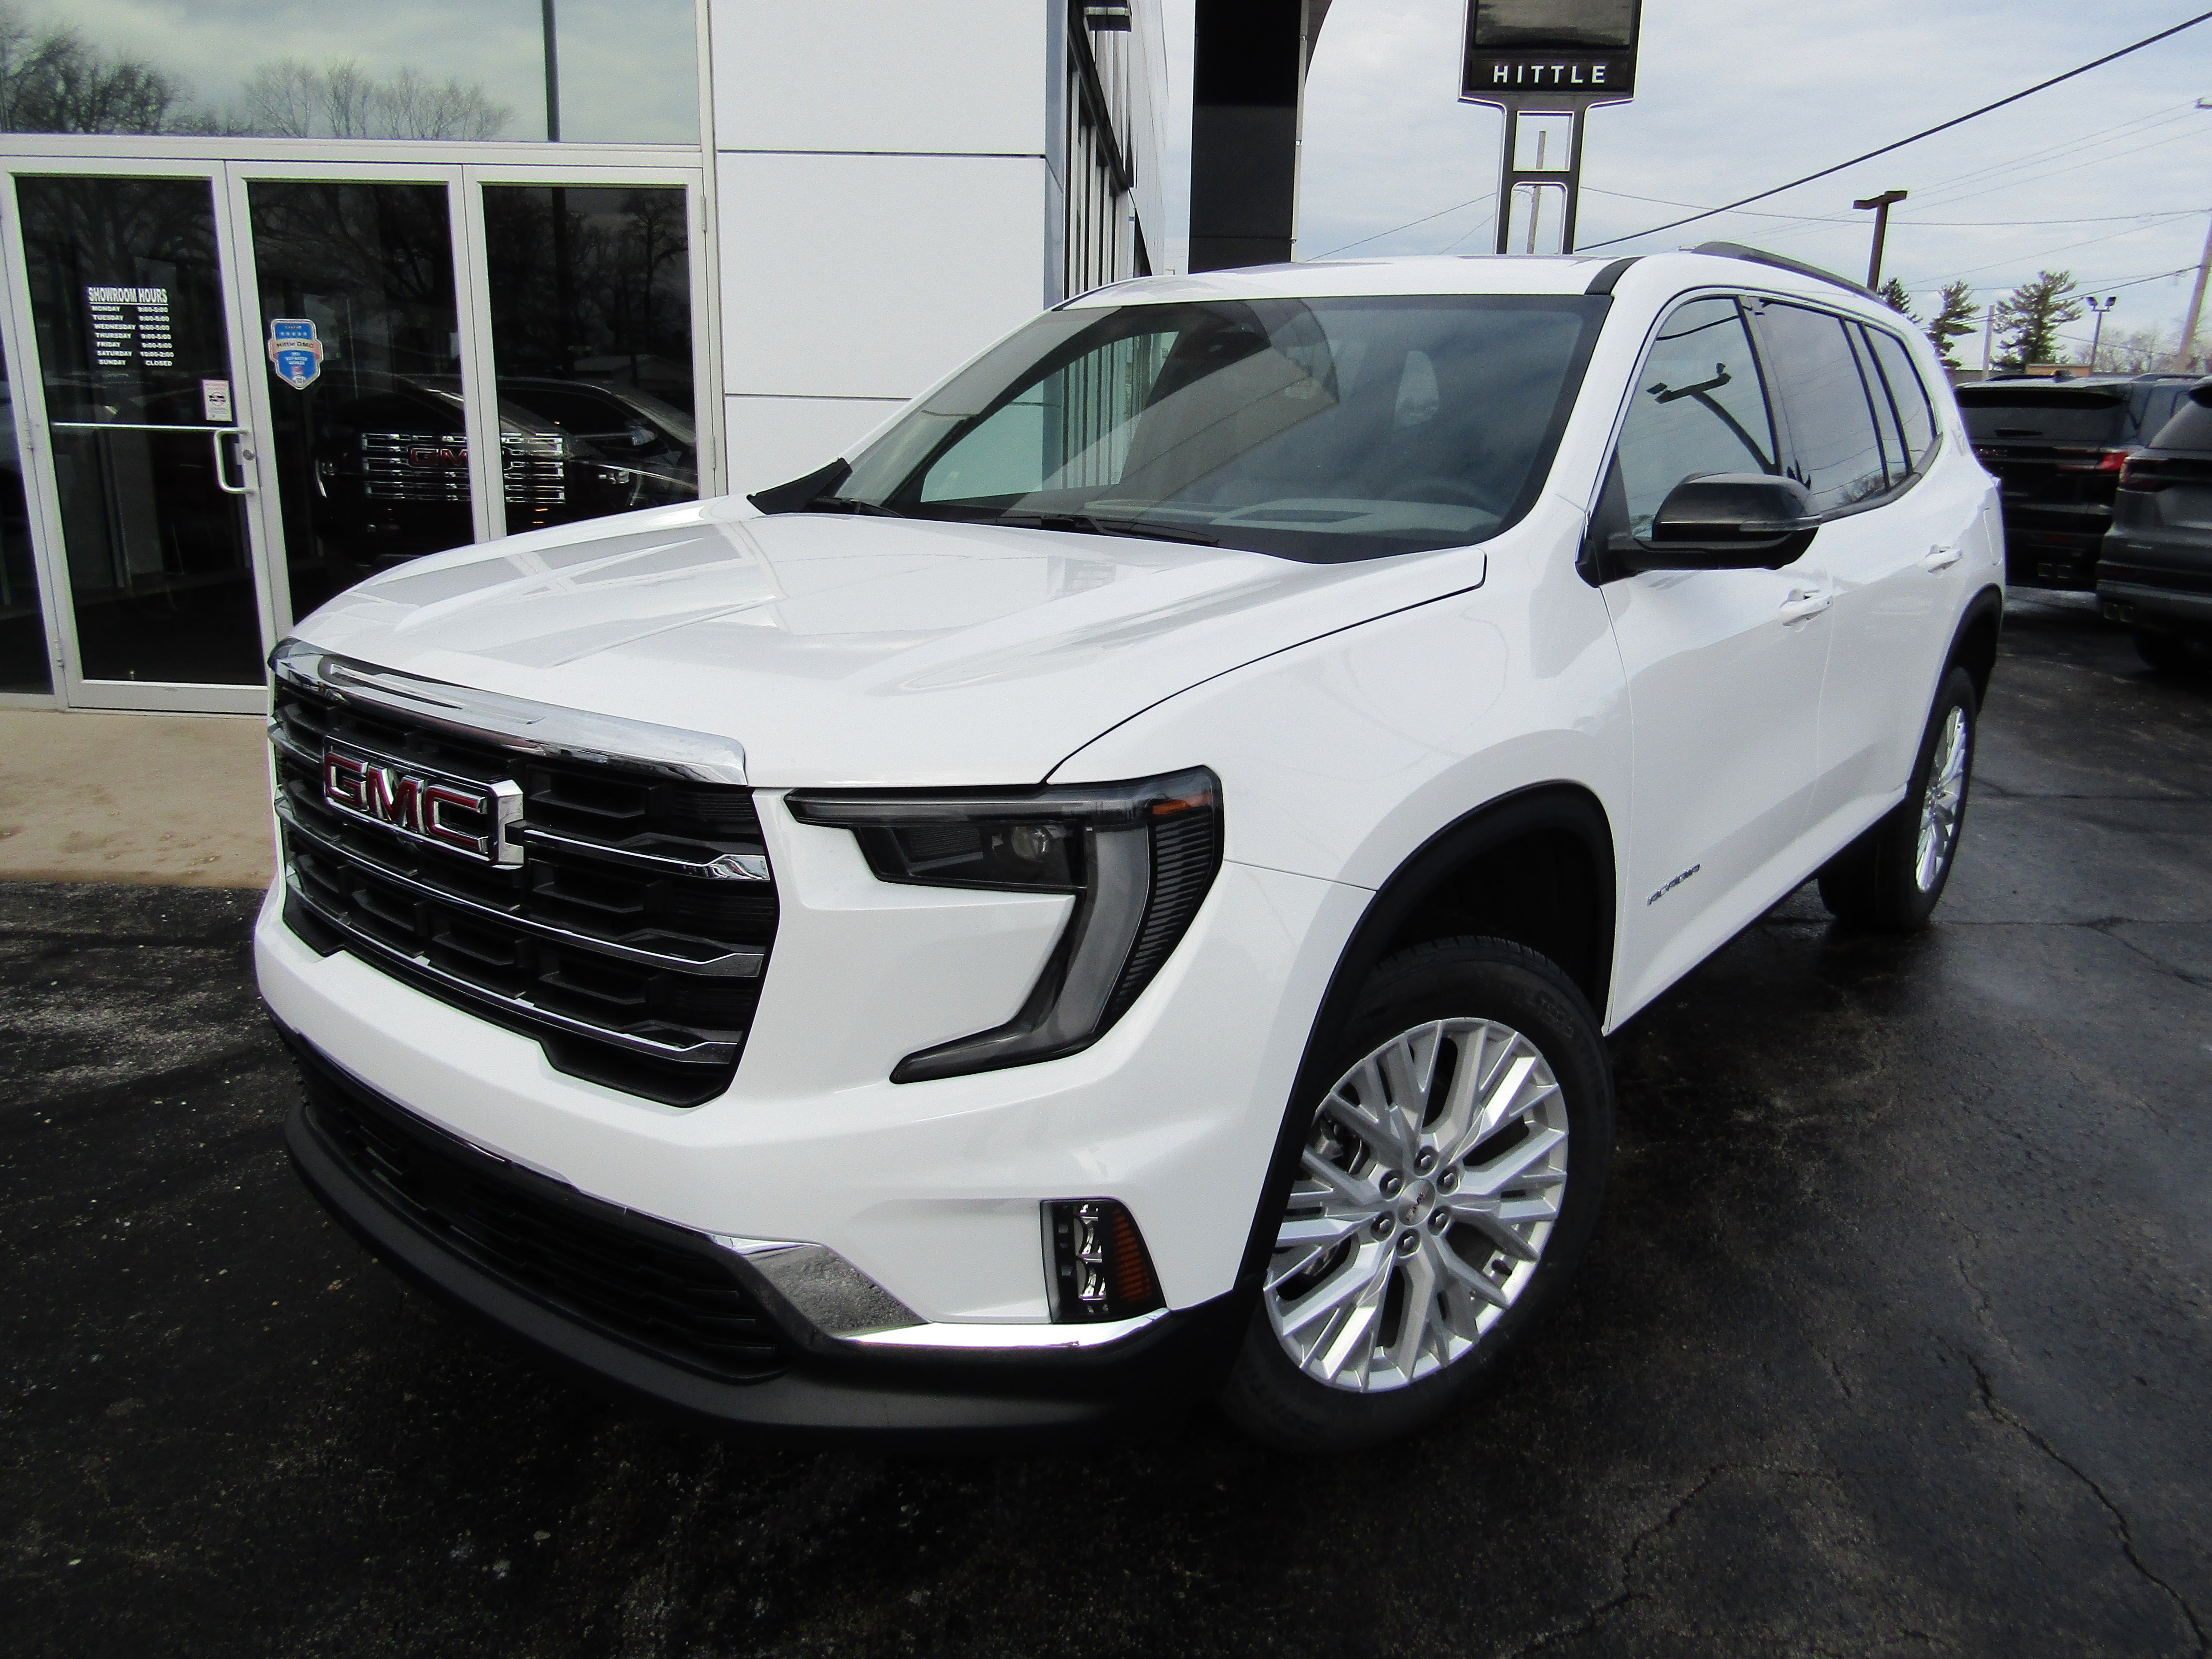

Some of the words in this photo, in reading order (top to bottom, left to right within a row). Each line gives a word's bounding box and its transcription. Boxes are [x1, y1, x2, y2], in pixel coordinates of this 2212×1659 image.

[1493, 65, 1607, 84] HITTLE
[88, 287, 137, 302] SHOWROOM
[138, 288, 168, 303] HOURS
[410, 447, 470, 467] GM
[324, 750, 491, 855] GMC
